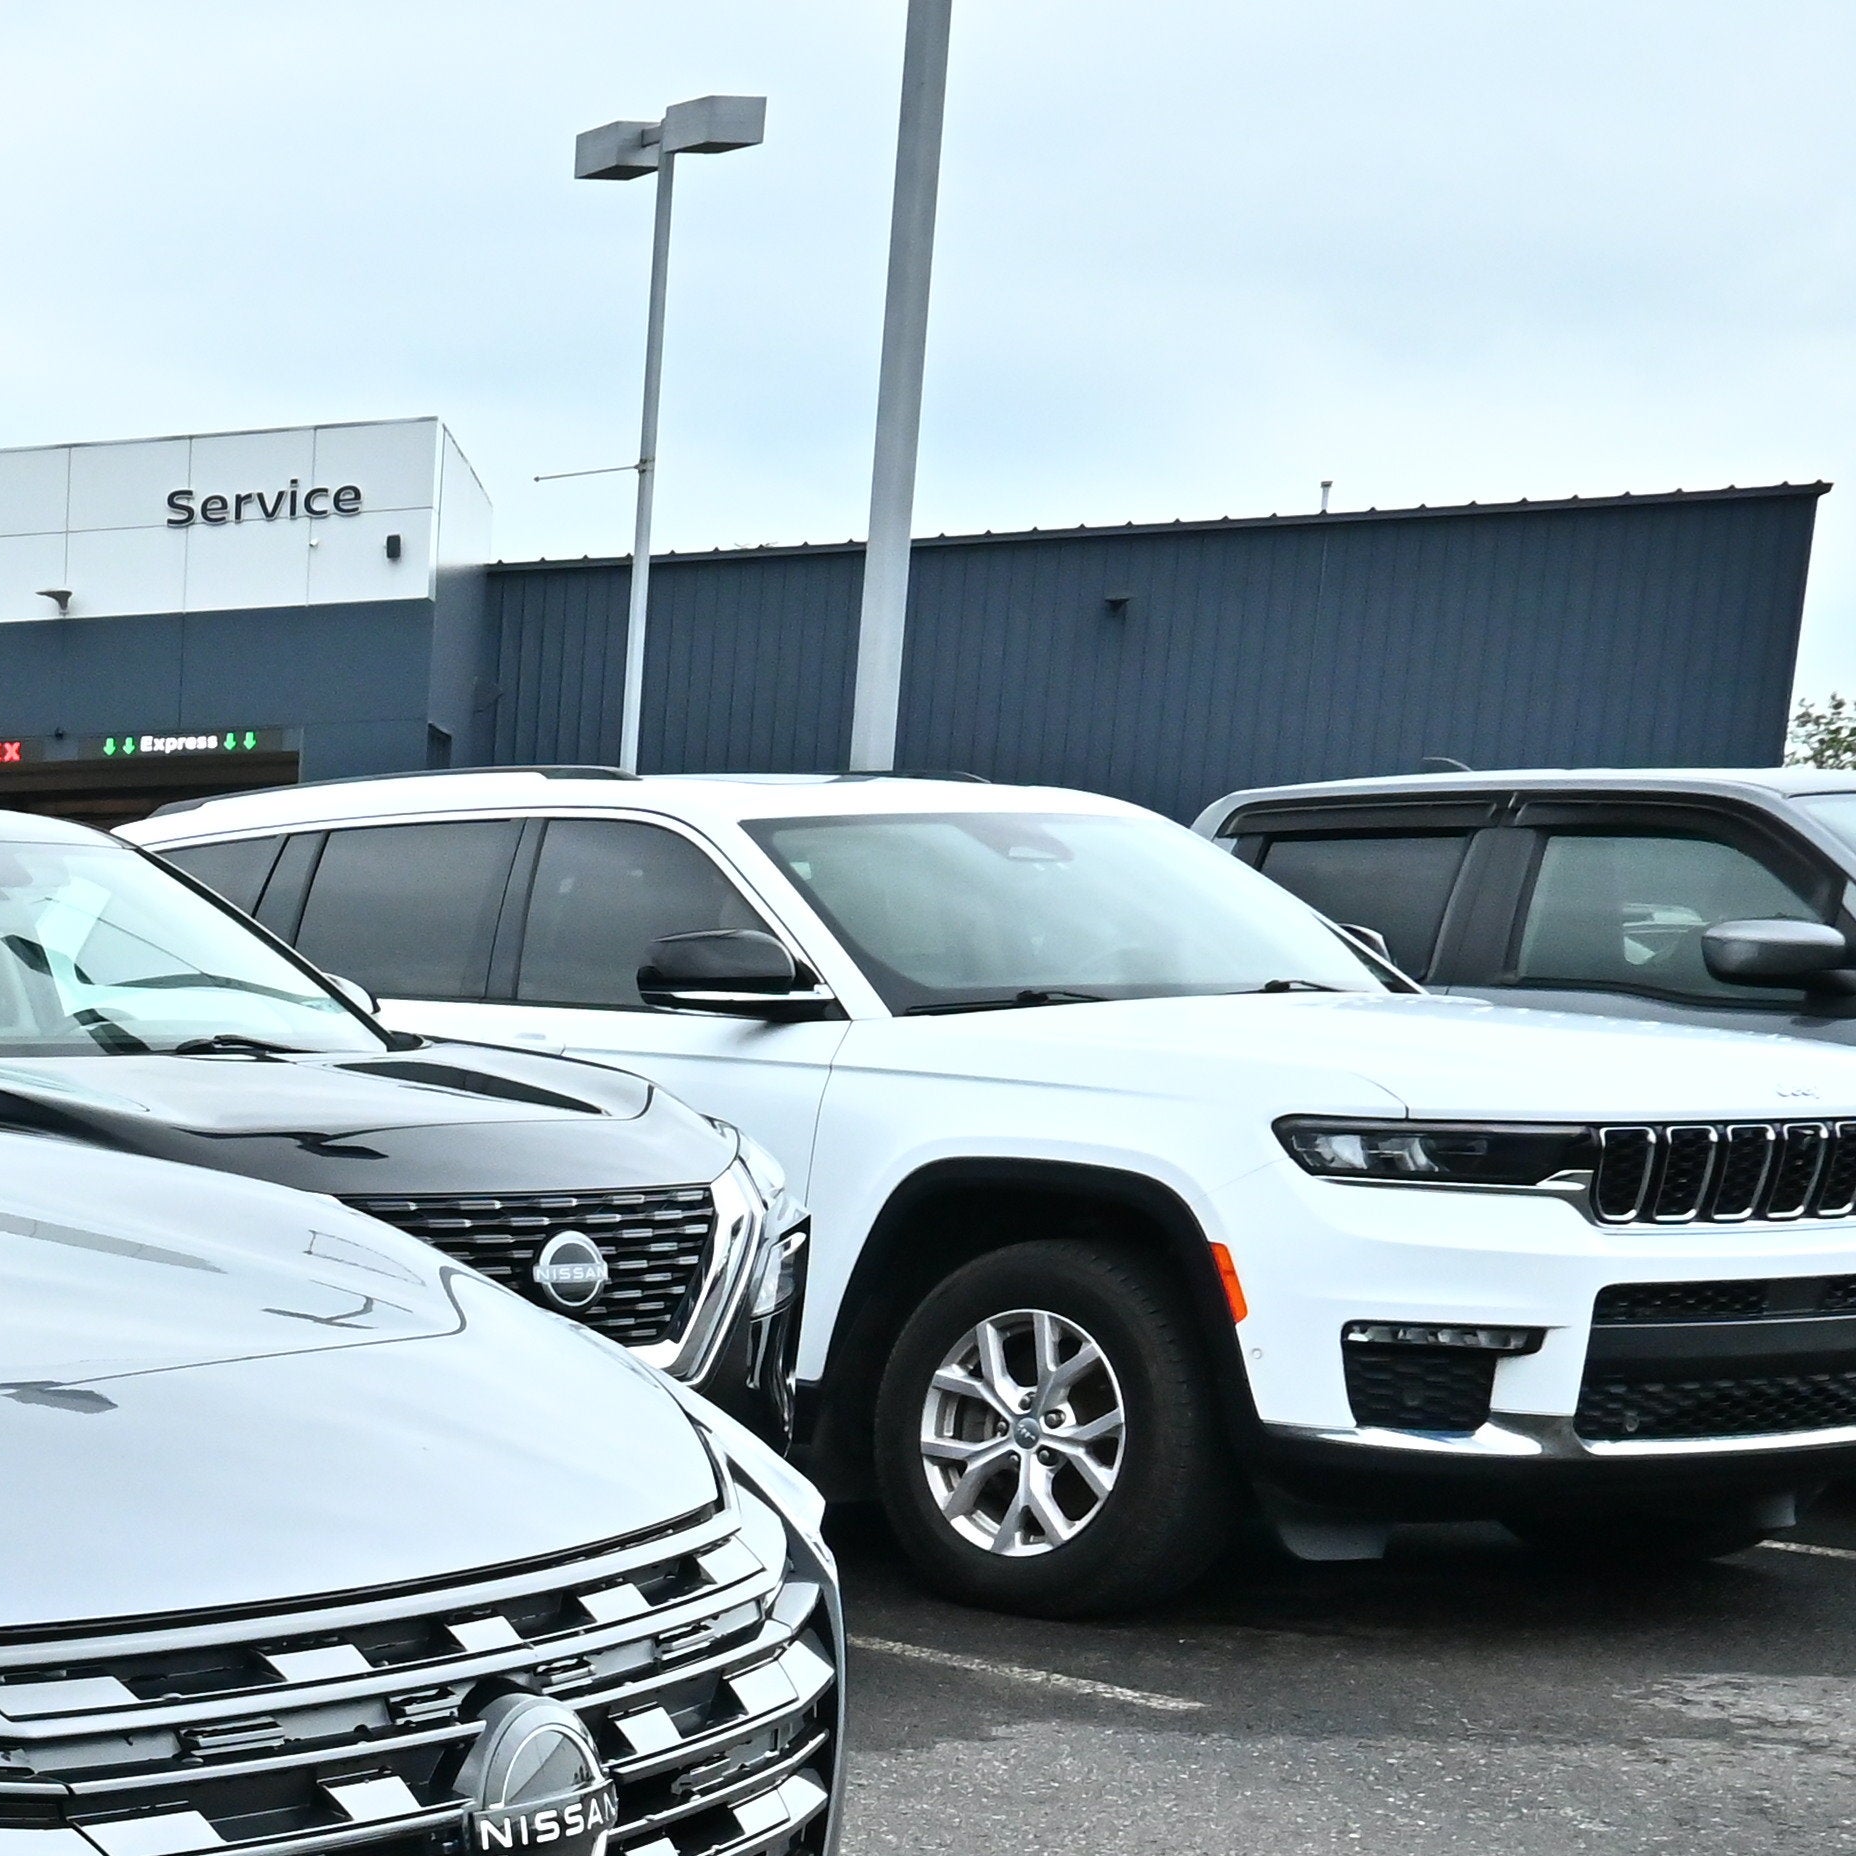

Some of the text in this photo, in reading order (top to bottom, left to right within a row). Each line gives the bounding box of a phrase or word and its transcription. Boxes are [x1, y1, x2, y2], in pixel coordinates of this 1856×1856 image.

[166, 478, 363, 528] Service
[140, 734, 218, 754] Express
[536, 1266, 607, 1280] NISSAN
[480, 1792, 618, 1850] NISSAN
